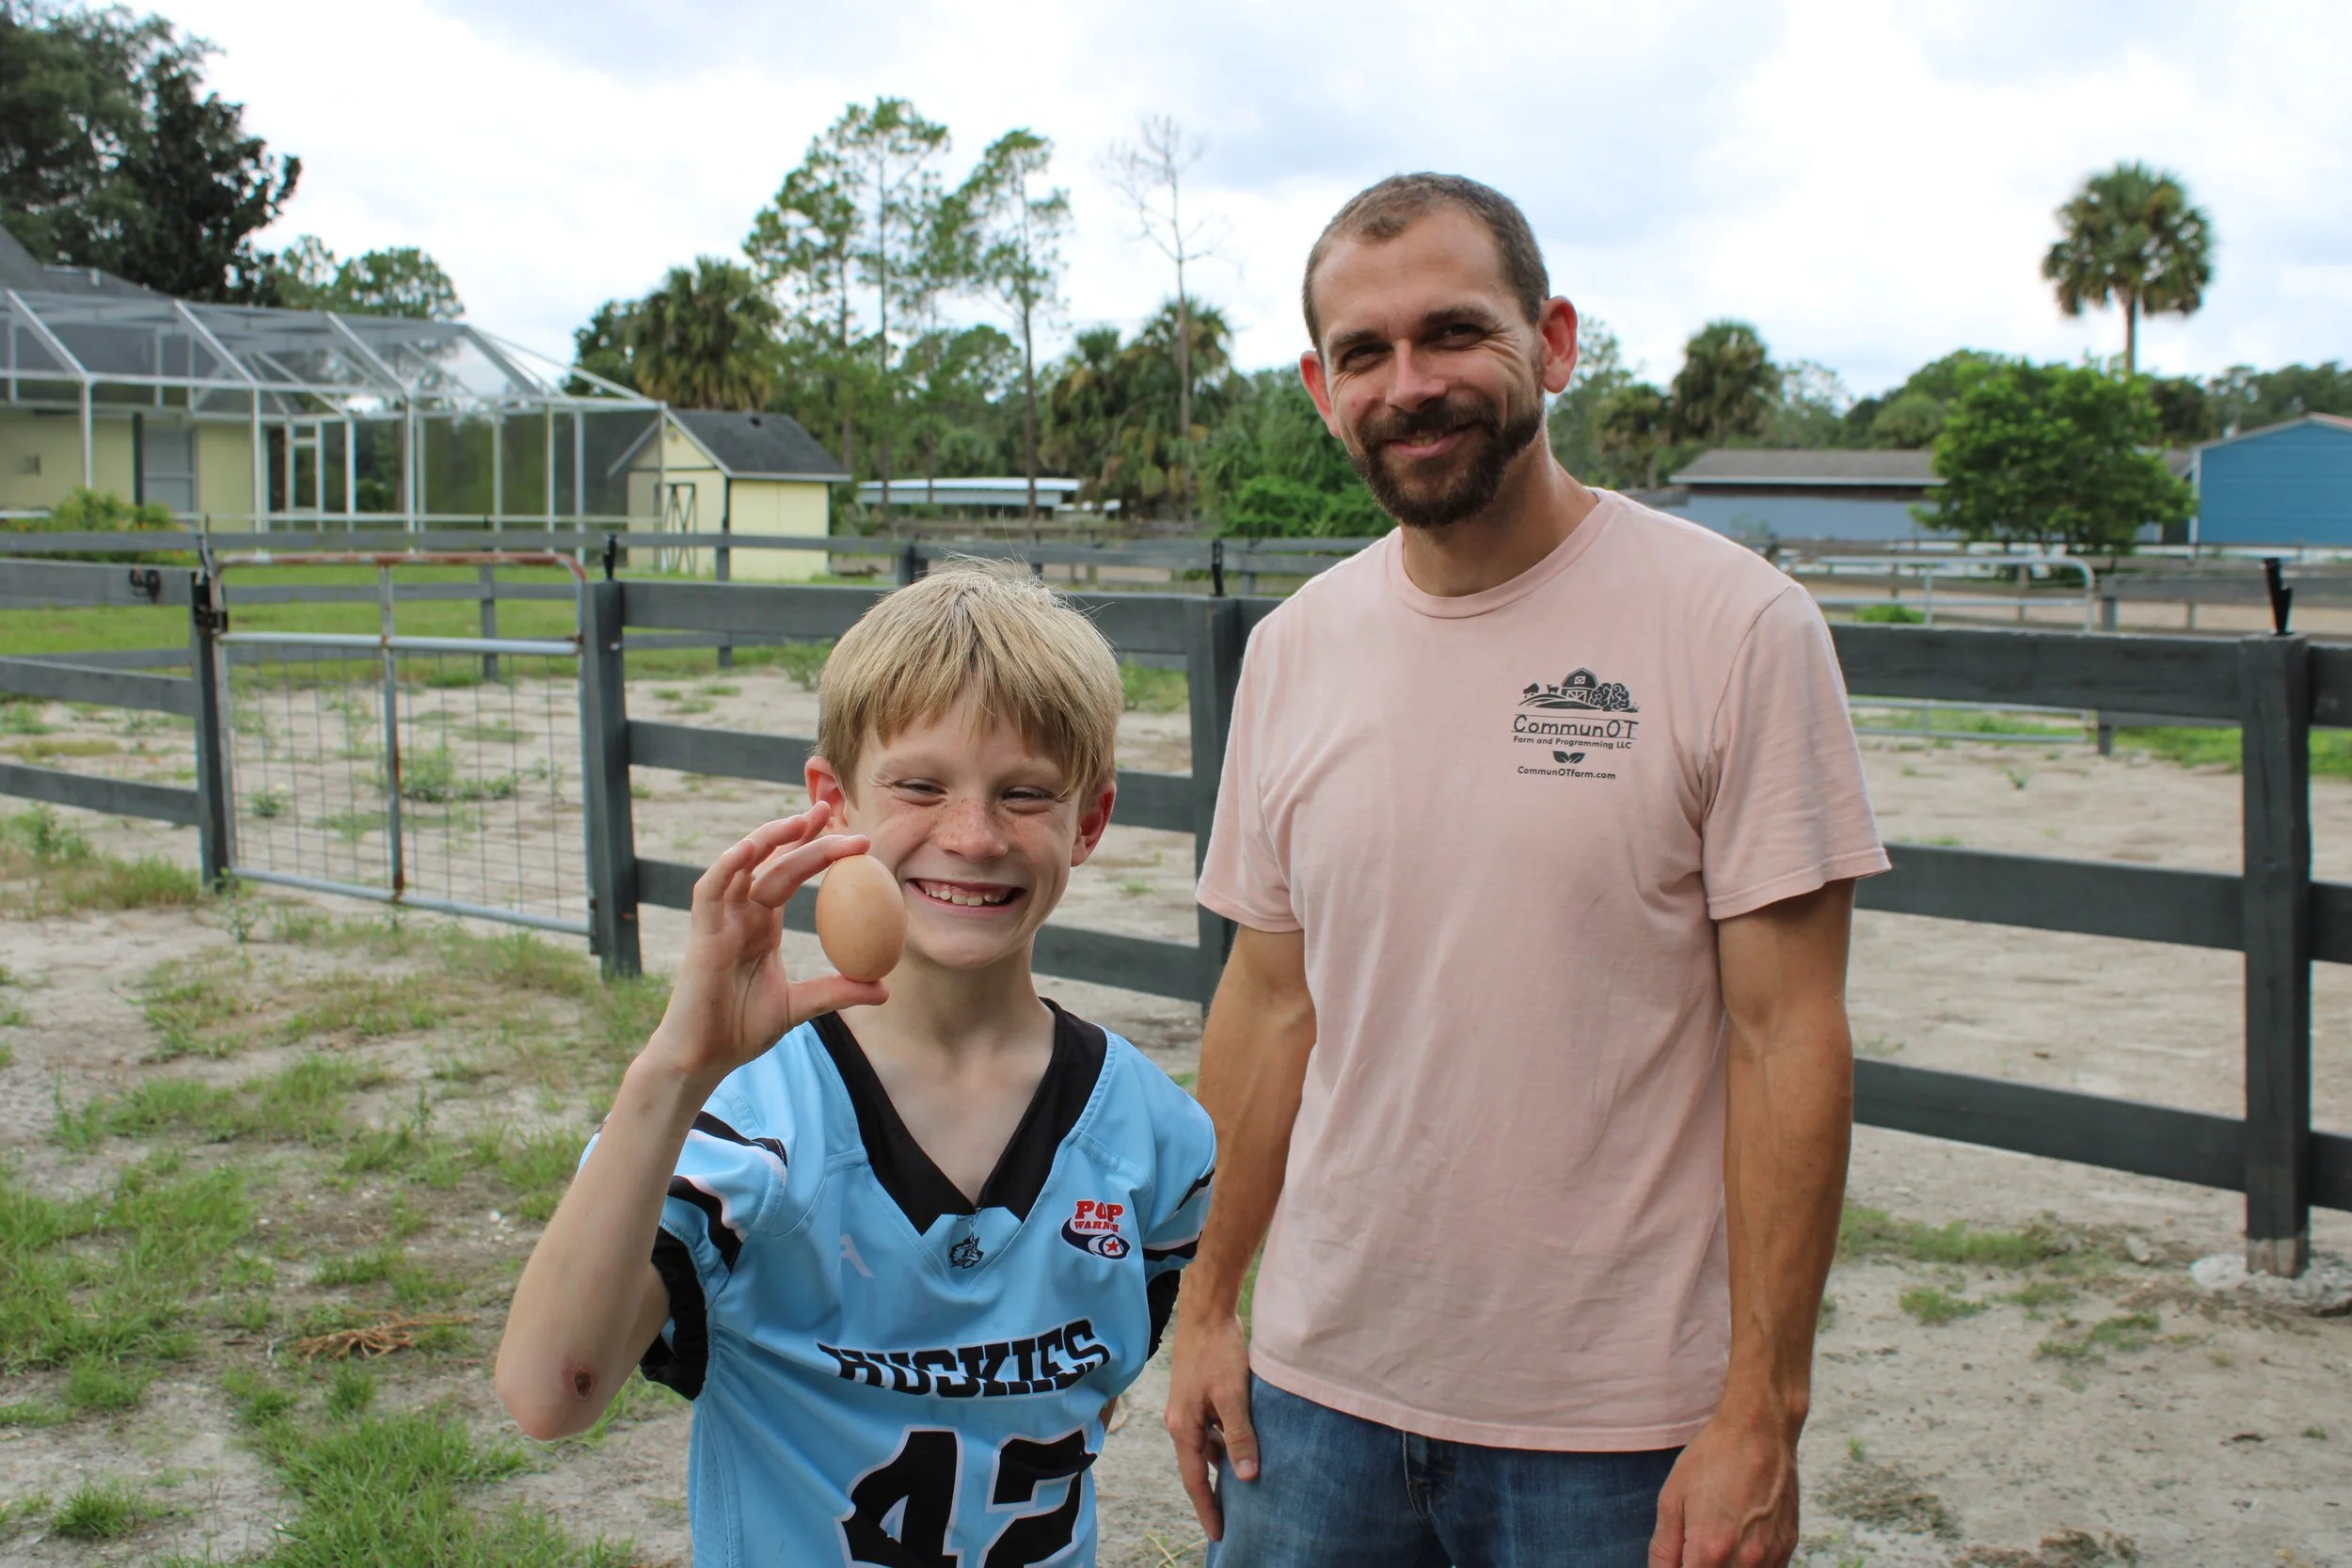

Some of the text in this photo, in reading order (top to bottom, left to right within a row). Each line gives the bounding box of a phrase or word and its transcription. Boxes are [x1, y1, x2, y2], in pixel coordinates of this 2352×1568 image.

[1514, 715, 1639, 738] CommunOT
[1513, 736, 1534, 744] Farm
[1555, 738, 1613, 750] Programming
[1518, 767, 1615, 780] CommunOTfarm.com
[1075, 1200, 1123, 1222] POP
[1074, 1221, 1120, 1232] WARNR
[817, 1318, 1111, 1398] HUSKIES
[837, 1428, 1098, 1568] 42
